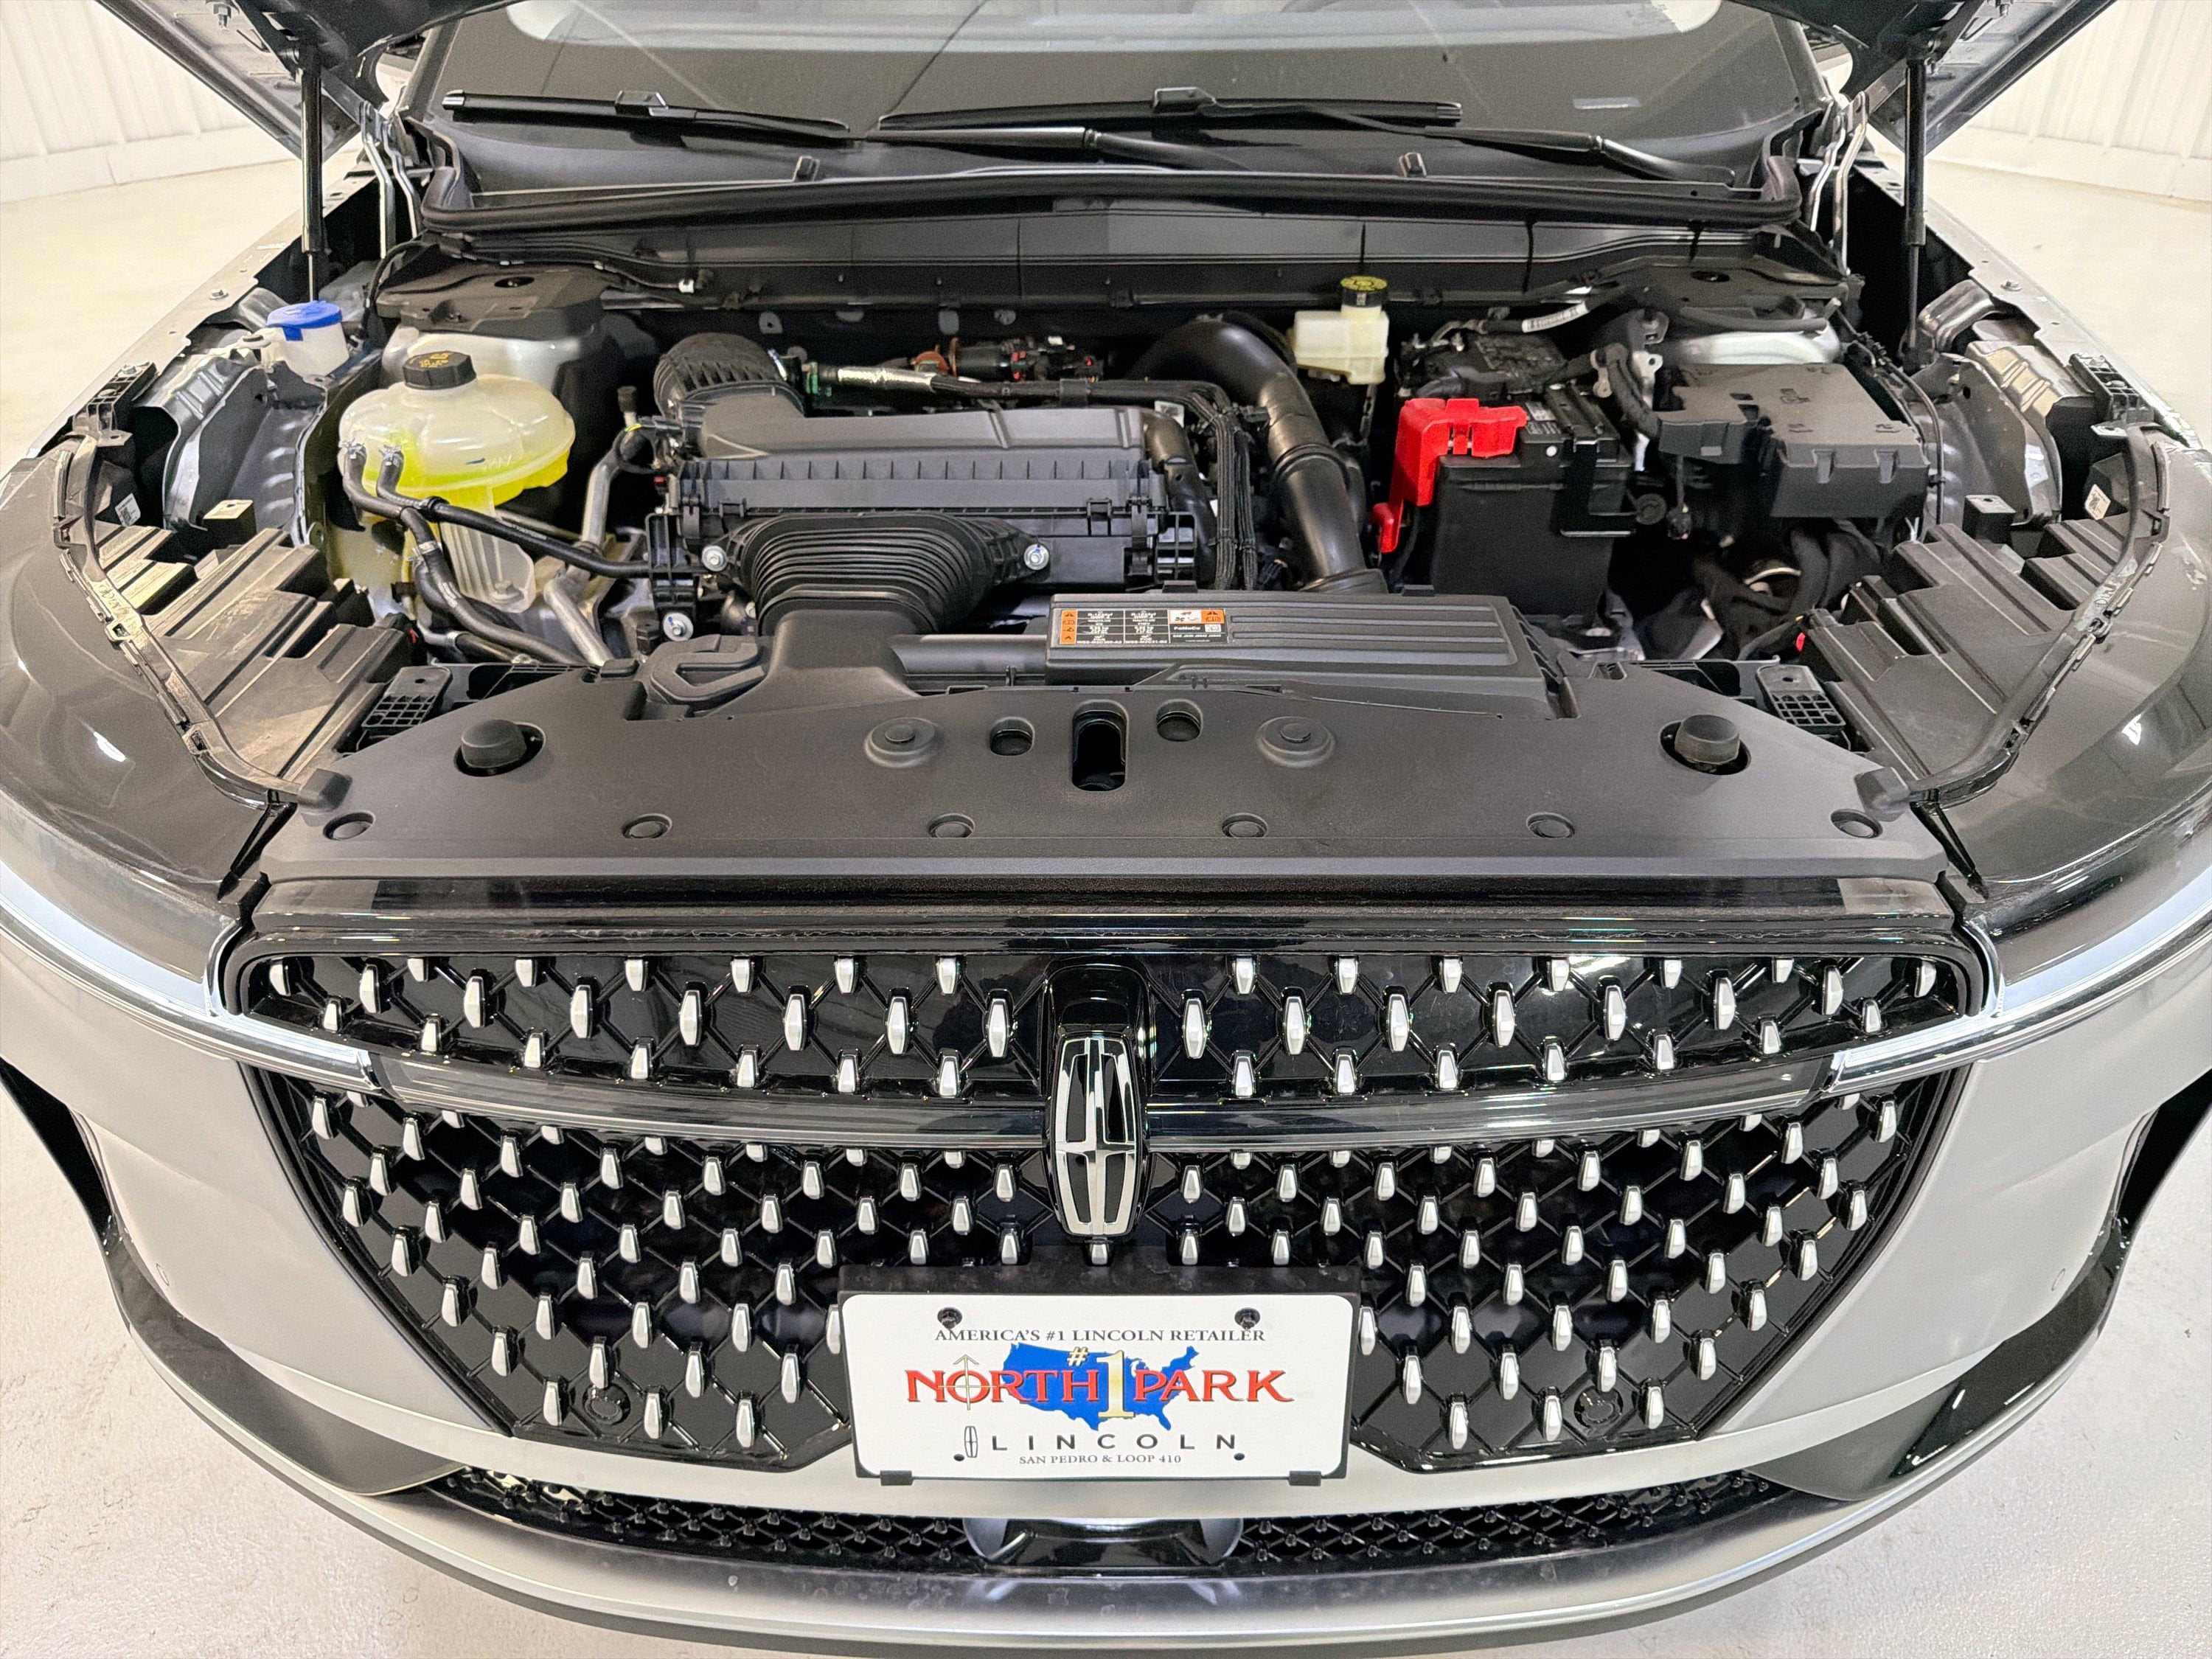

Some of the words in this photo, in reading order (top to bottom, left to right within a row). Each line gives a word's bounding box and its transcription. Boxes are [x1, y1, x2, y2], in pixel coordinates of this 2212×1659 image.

[934, 1329, 1040, 1341] AMERICA'S
[1046, 1330, 1064, 1341] #1
[1072, 1329, 1164, 1341] LINCOLN
[1169, 1329, 1266, 1341] RETAILER
[905, 1369, 1100, 1404] NORTH
[1133, 1369, 1295, 1403] PARK
[992, 1433, 1236, 1452] LINCOLN
[1019, 1455, 1046, 1464] SAN
[1050, 1455, 1098, 1464] PEDRO
[1102, 1455, 1112, 1463] &
[1117, 1454, 1155, 1464] LOOP
[1158, 1455, 1181, 1464] 410
